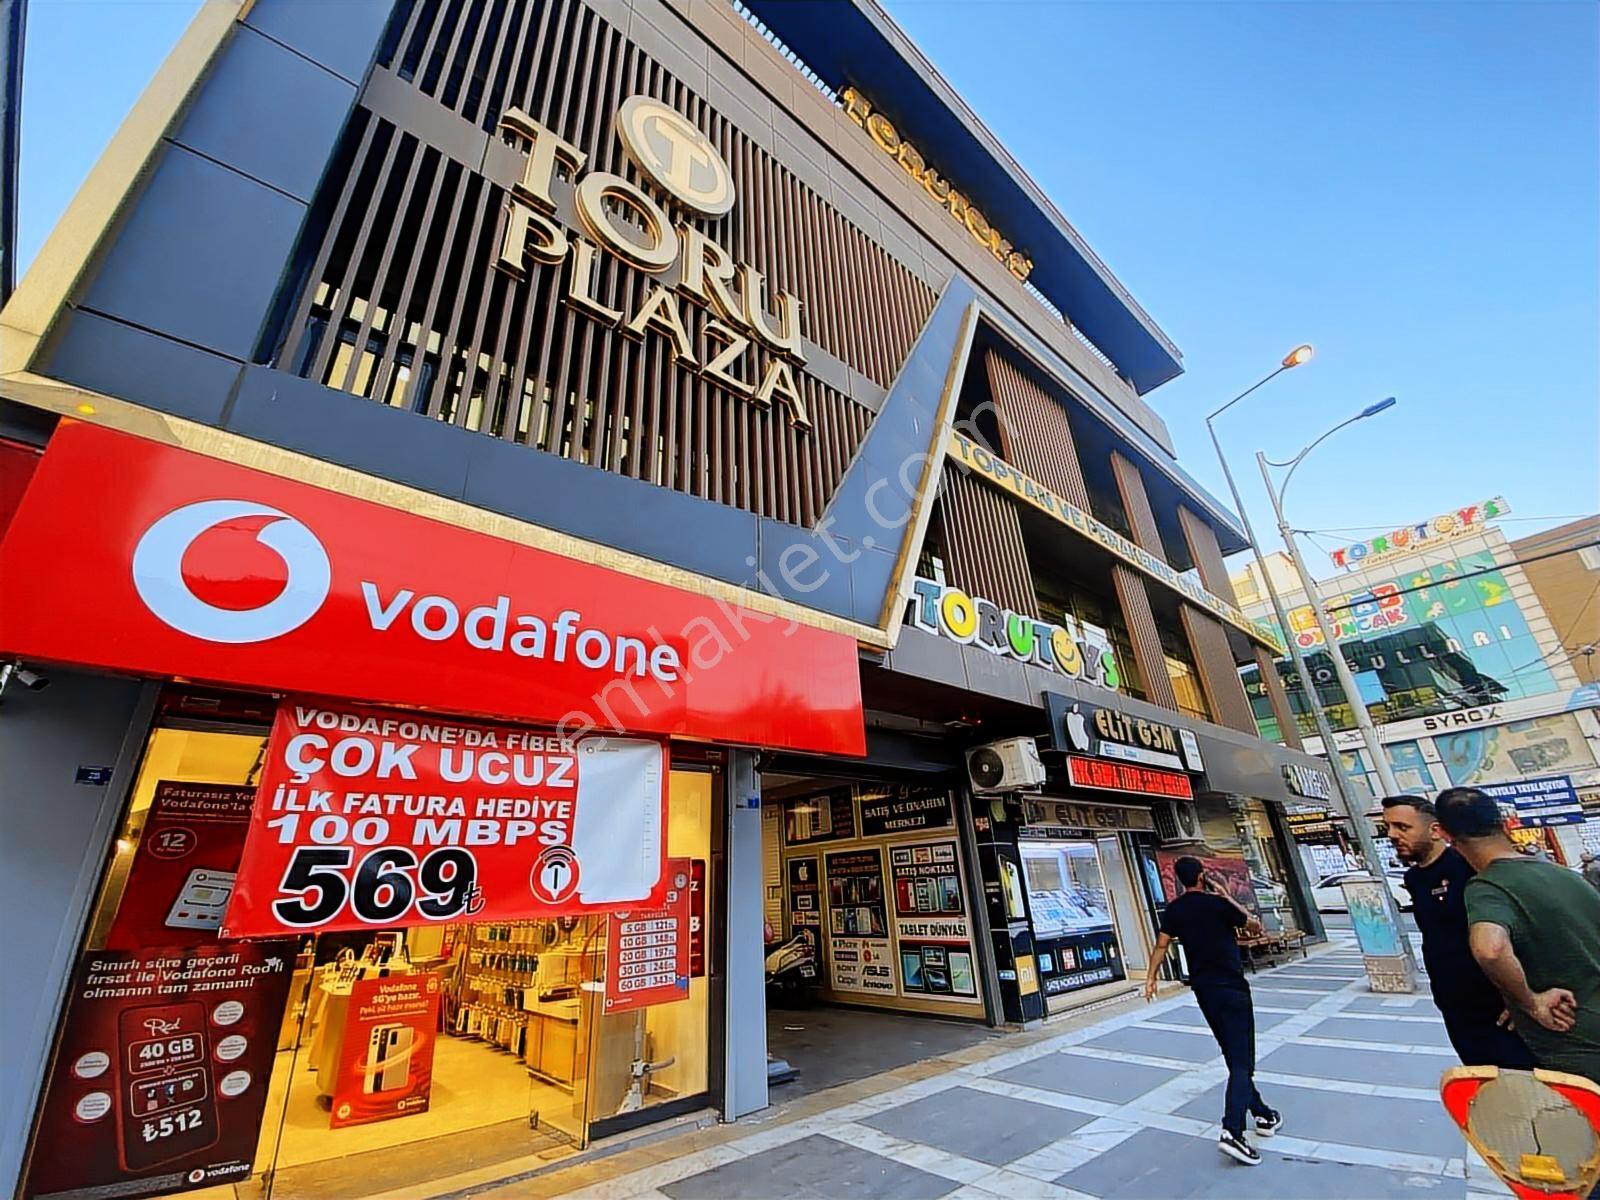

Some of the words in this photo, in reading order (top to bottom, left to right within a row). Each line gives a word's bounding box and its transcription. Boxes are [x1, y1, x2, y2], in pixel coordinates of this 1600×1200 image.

[499, 104, 807, 369] TORU
[492, 201, 812, 434] PLAZA
[953, 432, 1054, 513] TOPTAN
[1059, 500, 1085, 529] VE
[360, 580, 680, 682] vodafone
[913, 577, 1119, 692] TORUTOYS
[295, 706, 499, 750] VODAFONE'DA
[1424, 706, 1503, 731] SYROX
[1138, 719, 1178, 753] GSM
[284, 734, 418, 784] ÇOK
[439, 747, 575, 788] UCUZ
[272, 784, 334, 812] İLK
[343, 792, 467, 817] FATURA
[475, 795, 571, 819] HEDİYE
[160, 832, 186, 847] 12
[267, 815, 390, 844] 100
[412, 819, 568, 846] MBPS
[634, 923, 647, 932] GB
[623, 937, 633, 947] 10
[635, 936, 647, 946] GB
[90, 959, 141, 972] Sınırlı
[145, 957, 182, 969] süre
[186, 953, 240, 968] geçerli
[622, 951, 633, 961] 20
[634, 950, 647, 959] GB
[87, 973, 132, 985] fırsat
[161, 967, 236, 981] Vodafone
[621, 965, 633, 976] 30
[634, 964, 647, 973] GB
[83, 985, 151, 999] olmanın
[157, 983, 189, 995] tam
[193, 977, 255, 991] zamanı!
[621, 979, 633, 990] 60
[634, 978, 647, 988] GB
[144, 1017, 181, 1037] Red
[139, 1043, 164, 1060] 40
[168, 1037, 195, 1054] GB
[206, 1162, 251, 1178] vodafone
